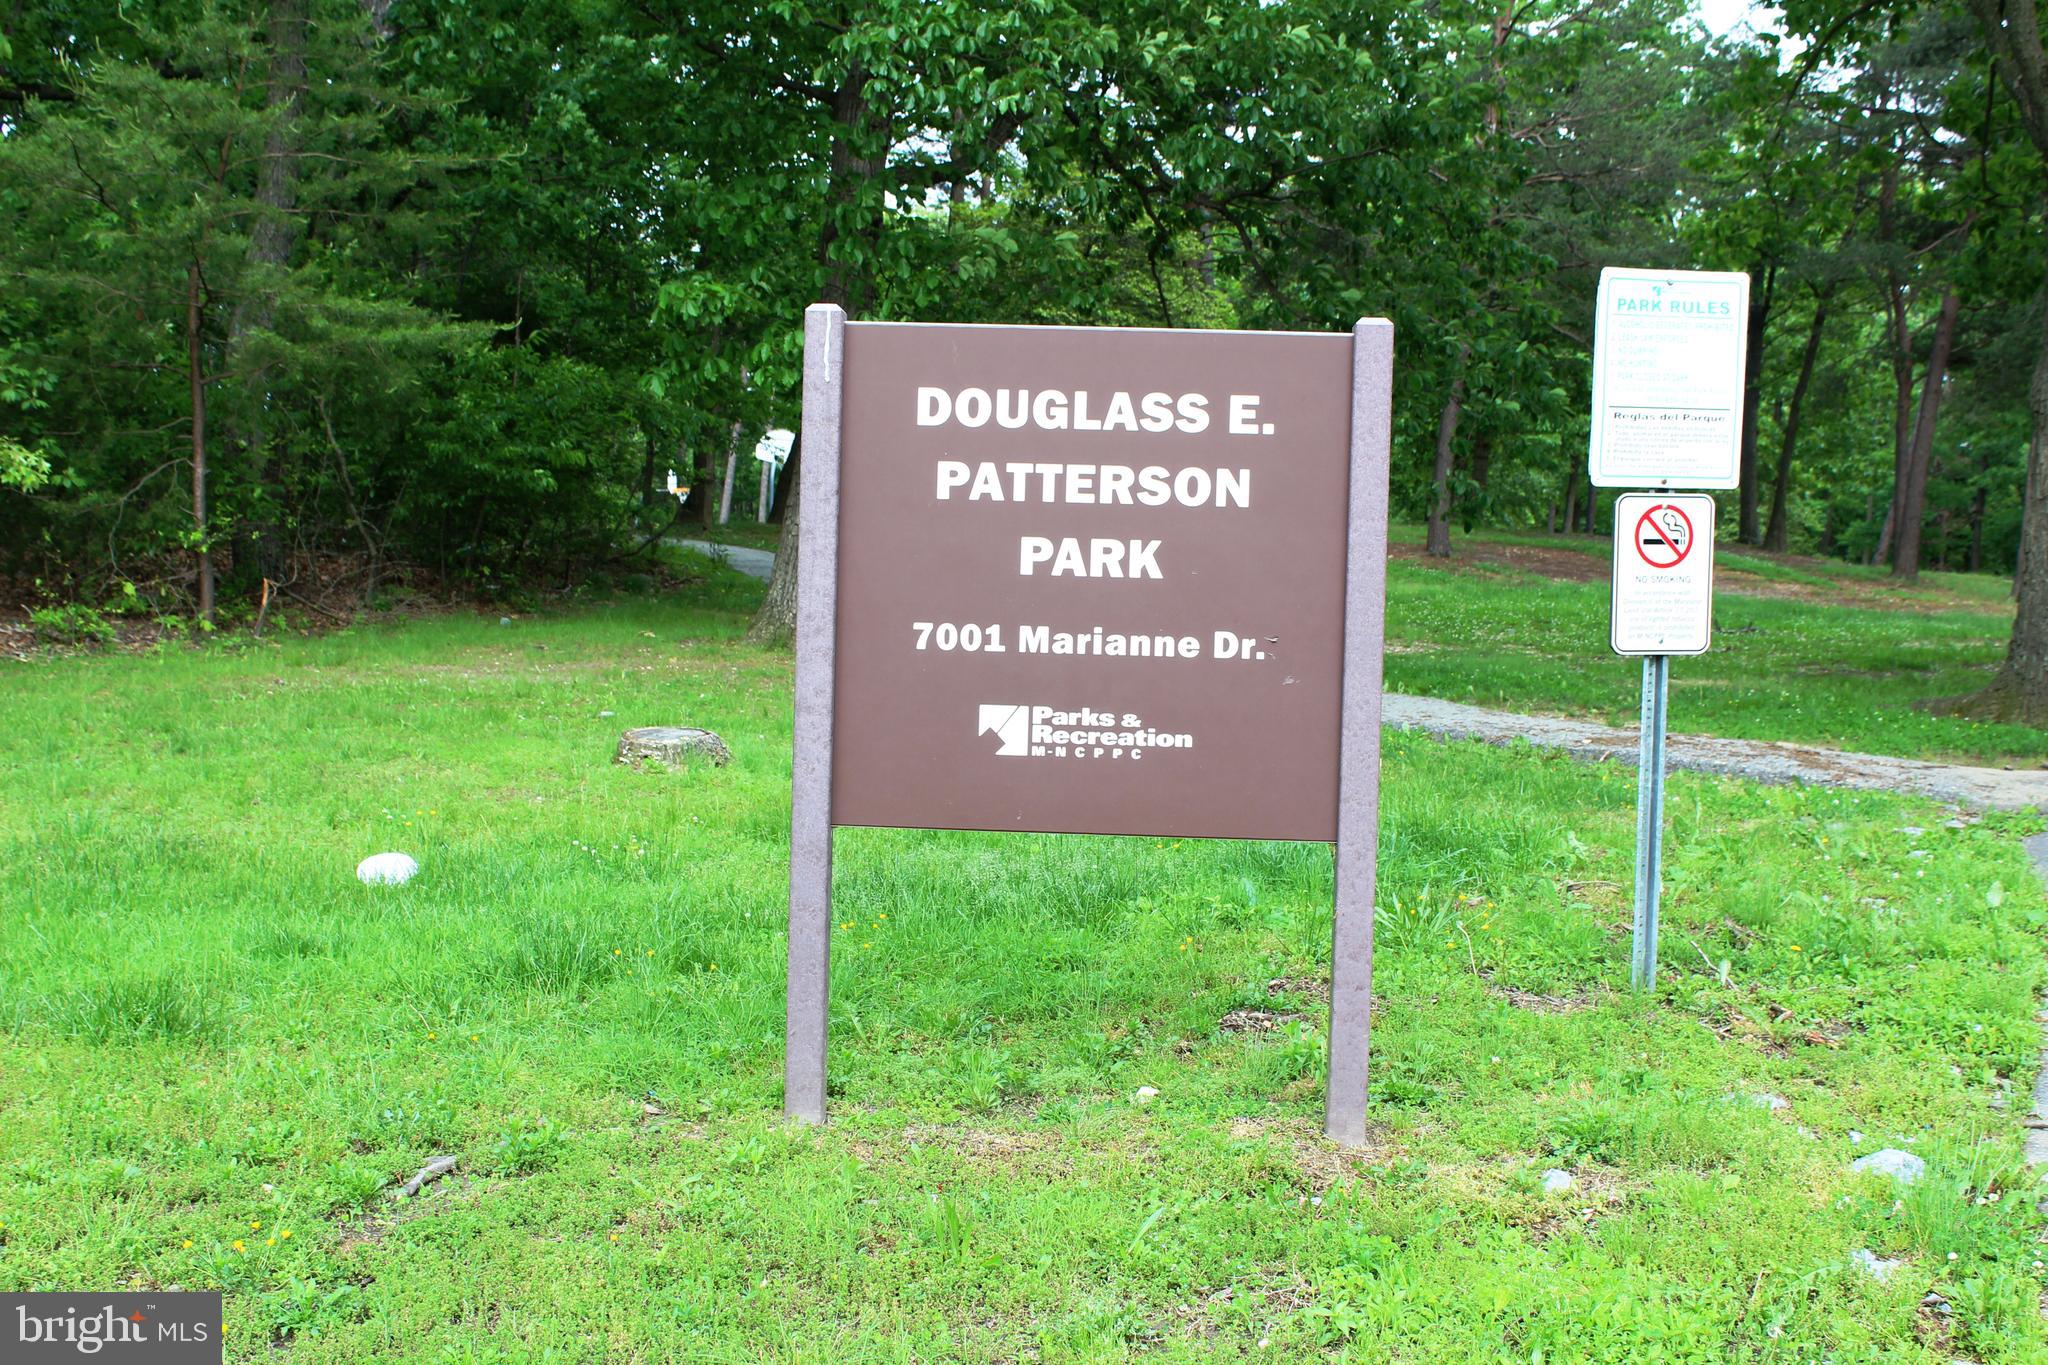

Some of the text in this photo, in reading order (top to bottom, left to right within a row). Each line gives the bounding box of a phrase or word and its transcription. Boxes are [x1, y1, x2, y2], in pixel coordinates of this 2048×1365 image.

[1617, 298, 1730, 315] PARK RULES
[917, 387, 1275, 434] DOUGLASS E.
[1613, 411, 1726, 423] Reglas del Parque
[937, 461, 1250, 507] PATTERSON
[1020, 537, 1164, 578] PARK
[1634, 575, 1692, 584] NO SMOKING
[912, 623, 1265, 660] 7001 Marianne Dr.
[1032, 706, 1142, 728] Parks &
[1032, 725, 1193, 748] Recreation
